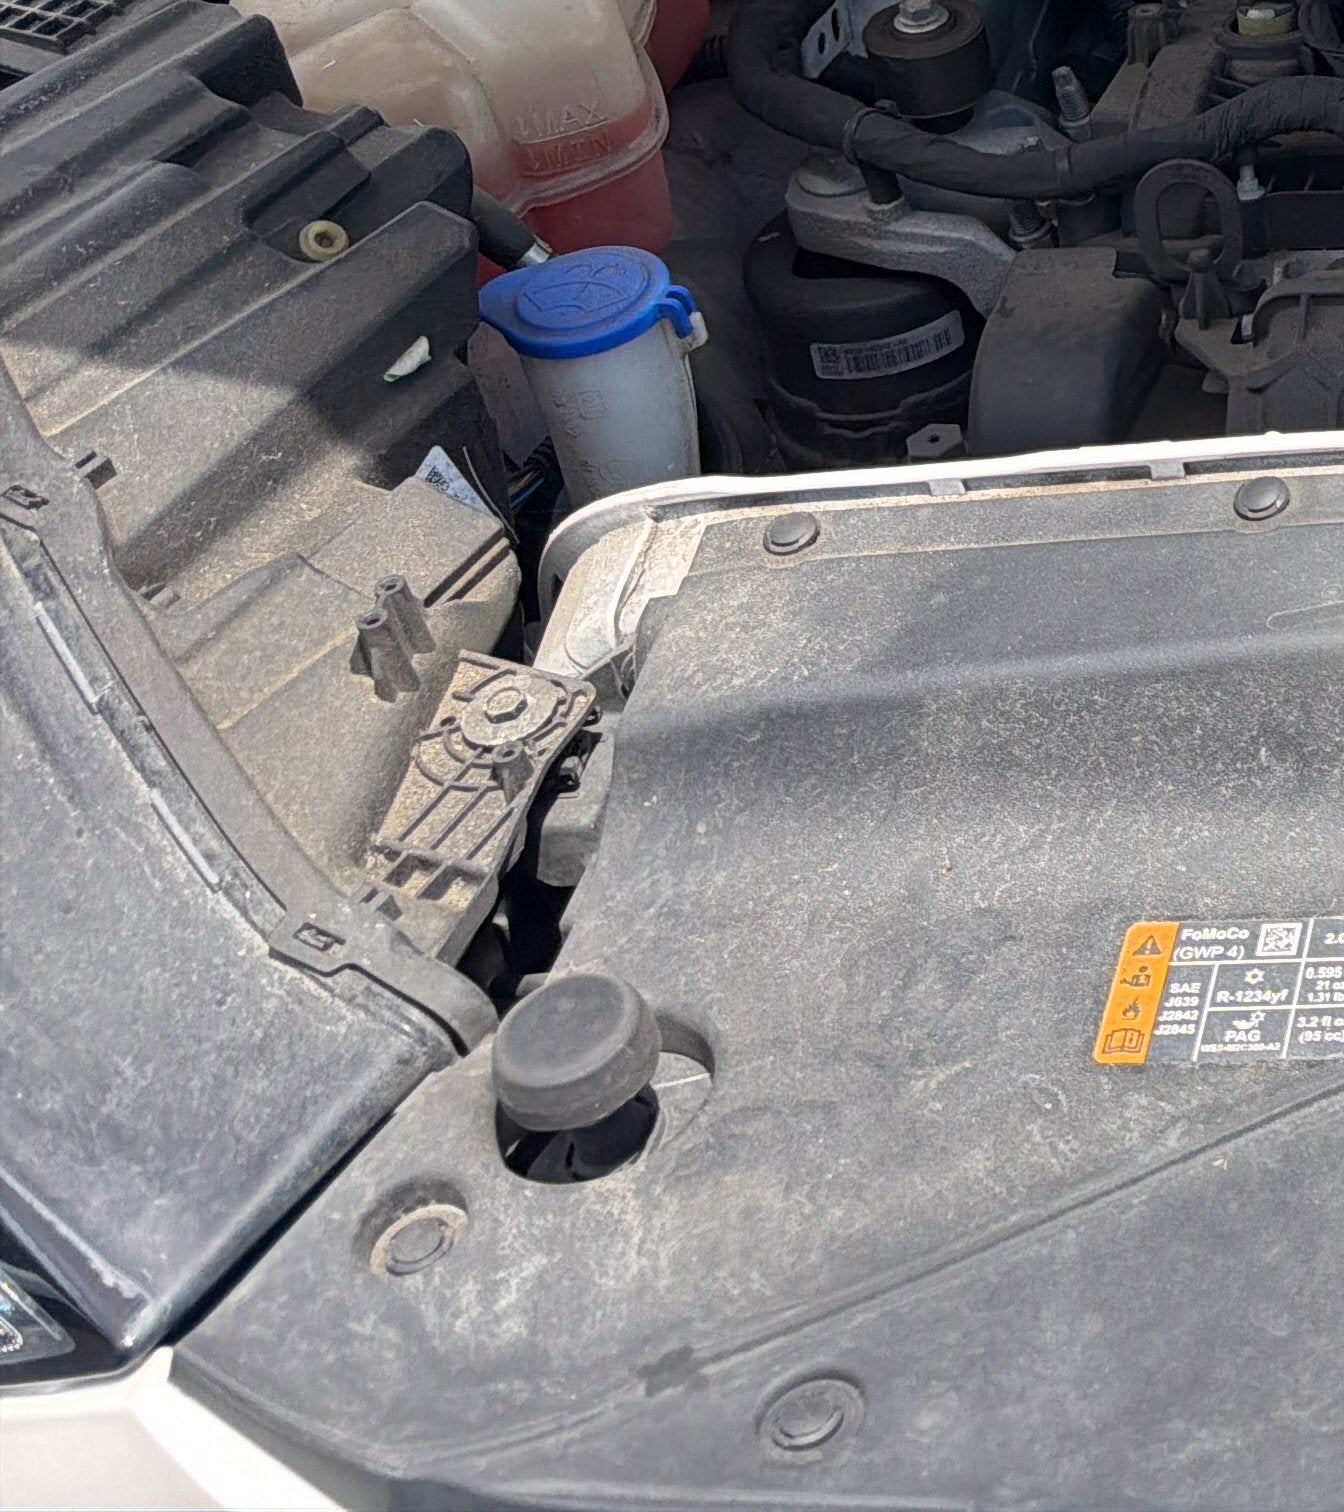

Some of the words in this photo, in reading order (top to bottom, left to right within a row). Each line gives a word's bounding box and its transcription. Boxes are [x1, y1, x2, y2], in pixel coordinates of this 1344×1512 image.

[531, 96, 607, 139] MAX
[1180, 925, 1250, 942] FoMoCo
[1172, 944, 1224, 961] (GWP
[1226, 944, 1245, 960] 4)
[1304, 965, 1342, 979] 0.595
[1168, 981, 1201, 993] SAE
[1315, 980, 1329, 990] 21
[1164, 996, 1199, 1007] J639
[1216, 987, 1289, 1006] R-1234yf
[1307, 991, 1330, 1002] 1.31
[1296, 1016, 1318, 1028] 3.2
[1320, 1015, 1331, 1026] fl
[1154, 1023, 1196, 1036] J2845
[1224, 1028, 1261, 1042] PAG
[1298, 1030, 1321, 1044] (95
